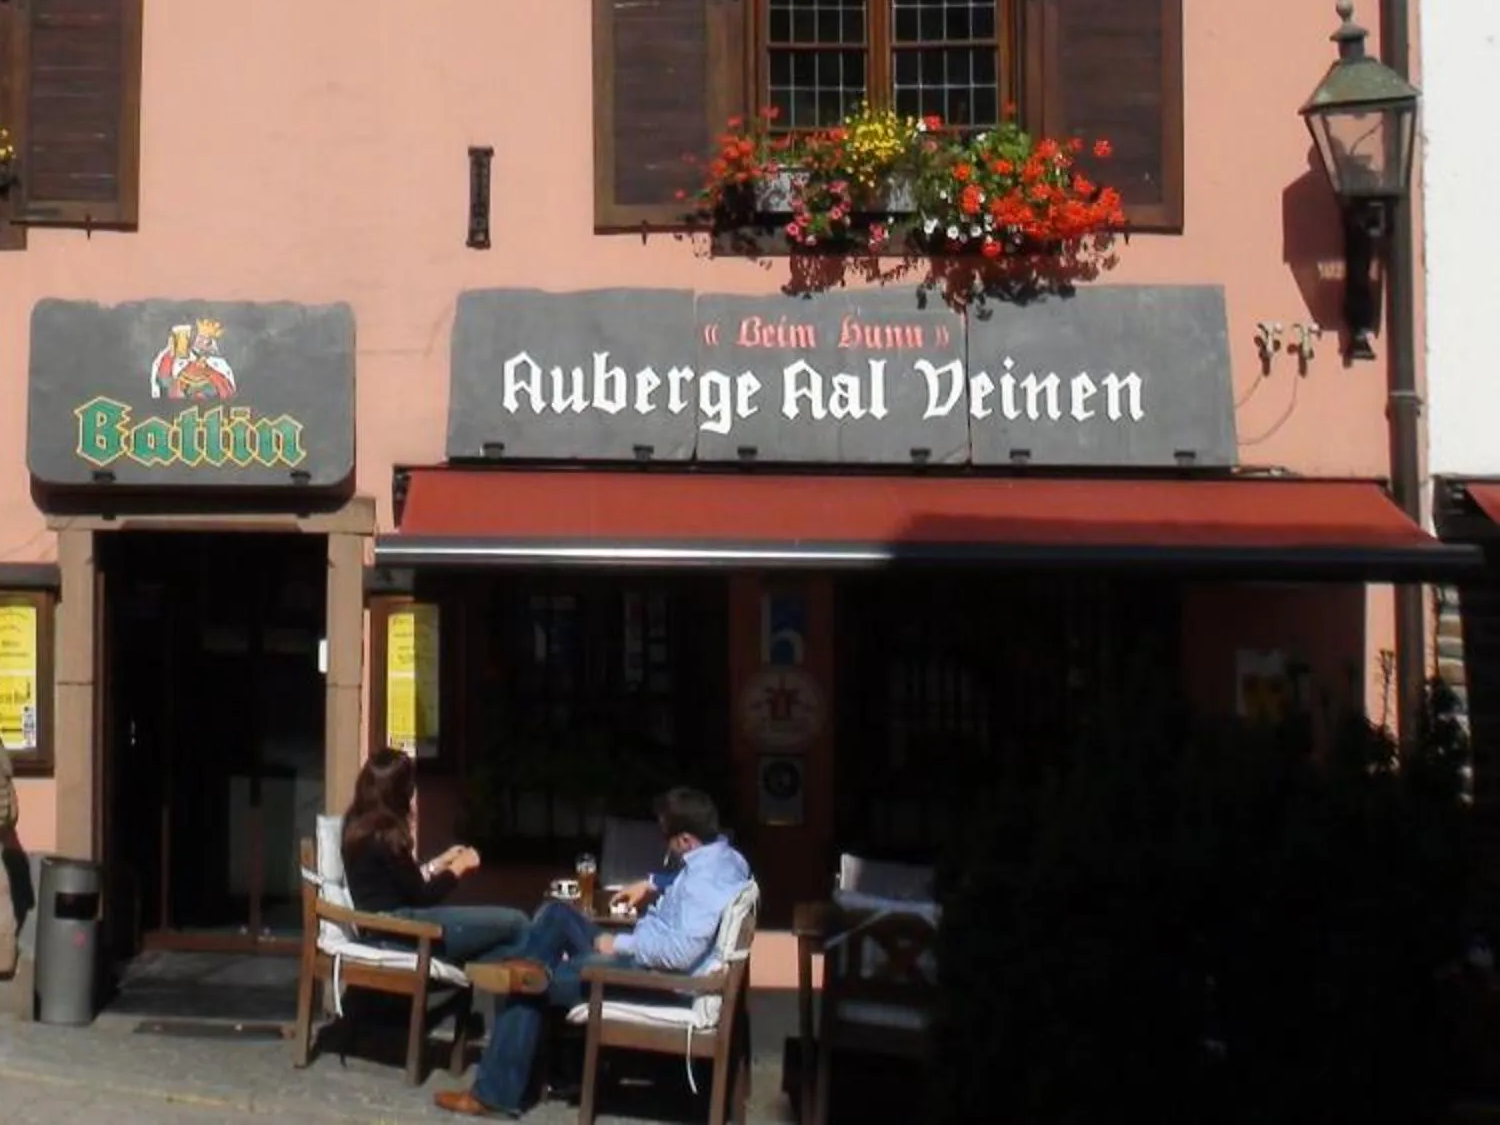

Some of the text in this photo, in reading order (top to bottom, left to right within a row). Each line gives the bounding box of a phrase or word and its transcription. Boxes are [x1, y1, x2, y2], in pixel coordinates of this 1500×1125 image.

[736, 315, 817, 348] Beim
[837, 315, 924, 349] Hunn
[502, 351, 1145, 435] Auberge Aal Veinen
[74, 396, 306, 467] Battin
